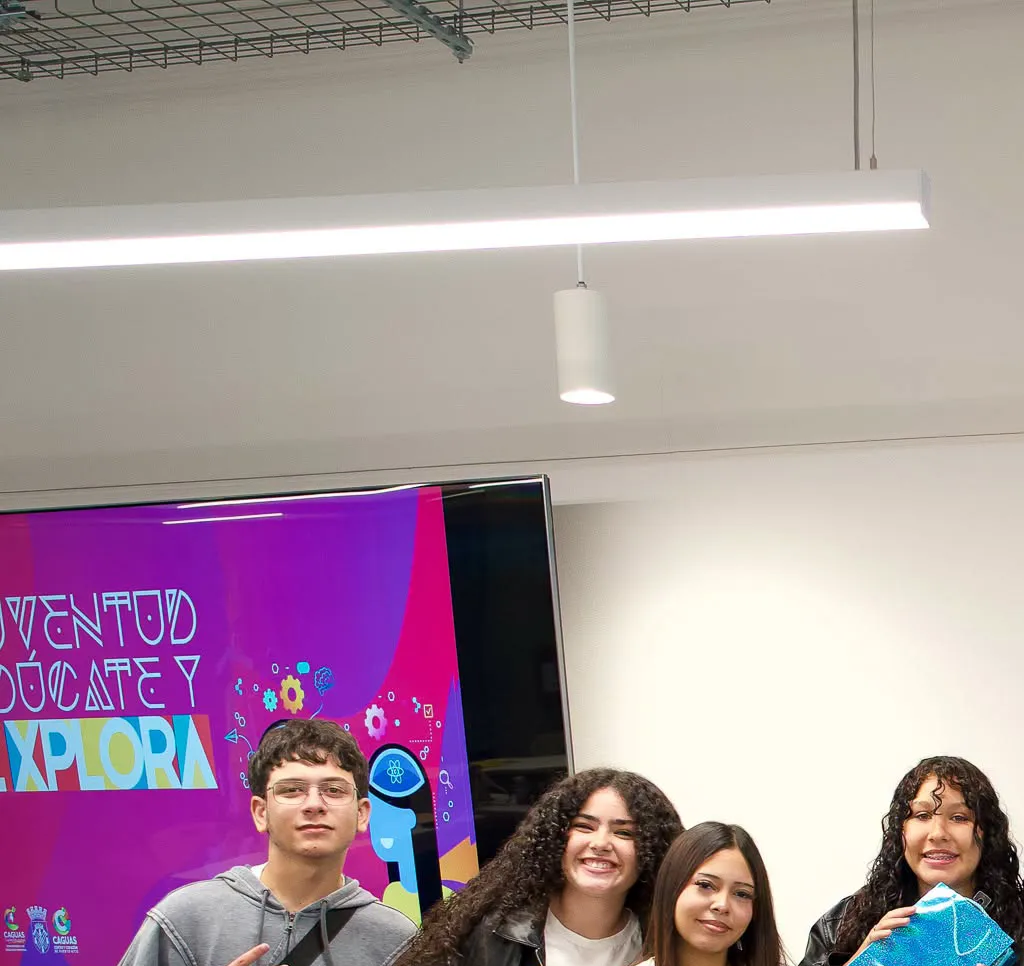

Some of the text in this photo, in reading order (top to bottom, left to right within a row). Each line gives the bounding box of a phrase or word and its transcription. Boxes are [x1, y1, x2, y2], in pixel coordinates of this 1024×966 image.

[0, 588, 197, 650] VENTUD
[173, 655, 201, 708] Y
[0, 714, 218, 792] XPLORA
[52, 936, 78, 945] CAGUAS
